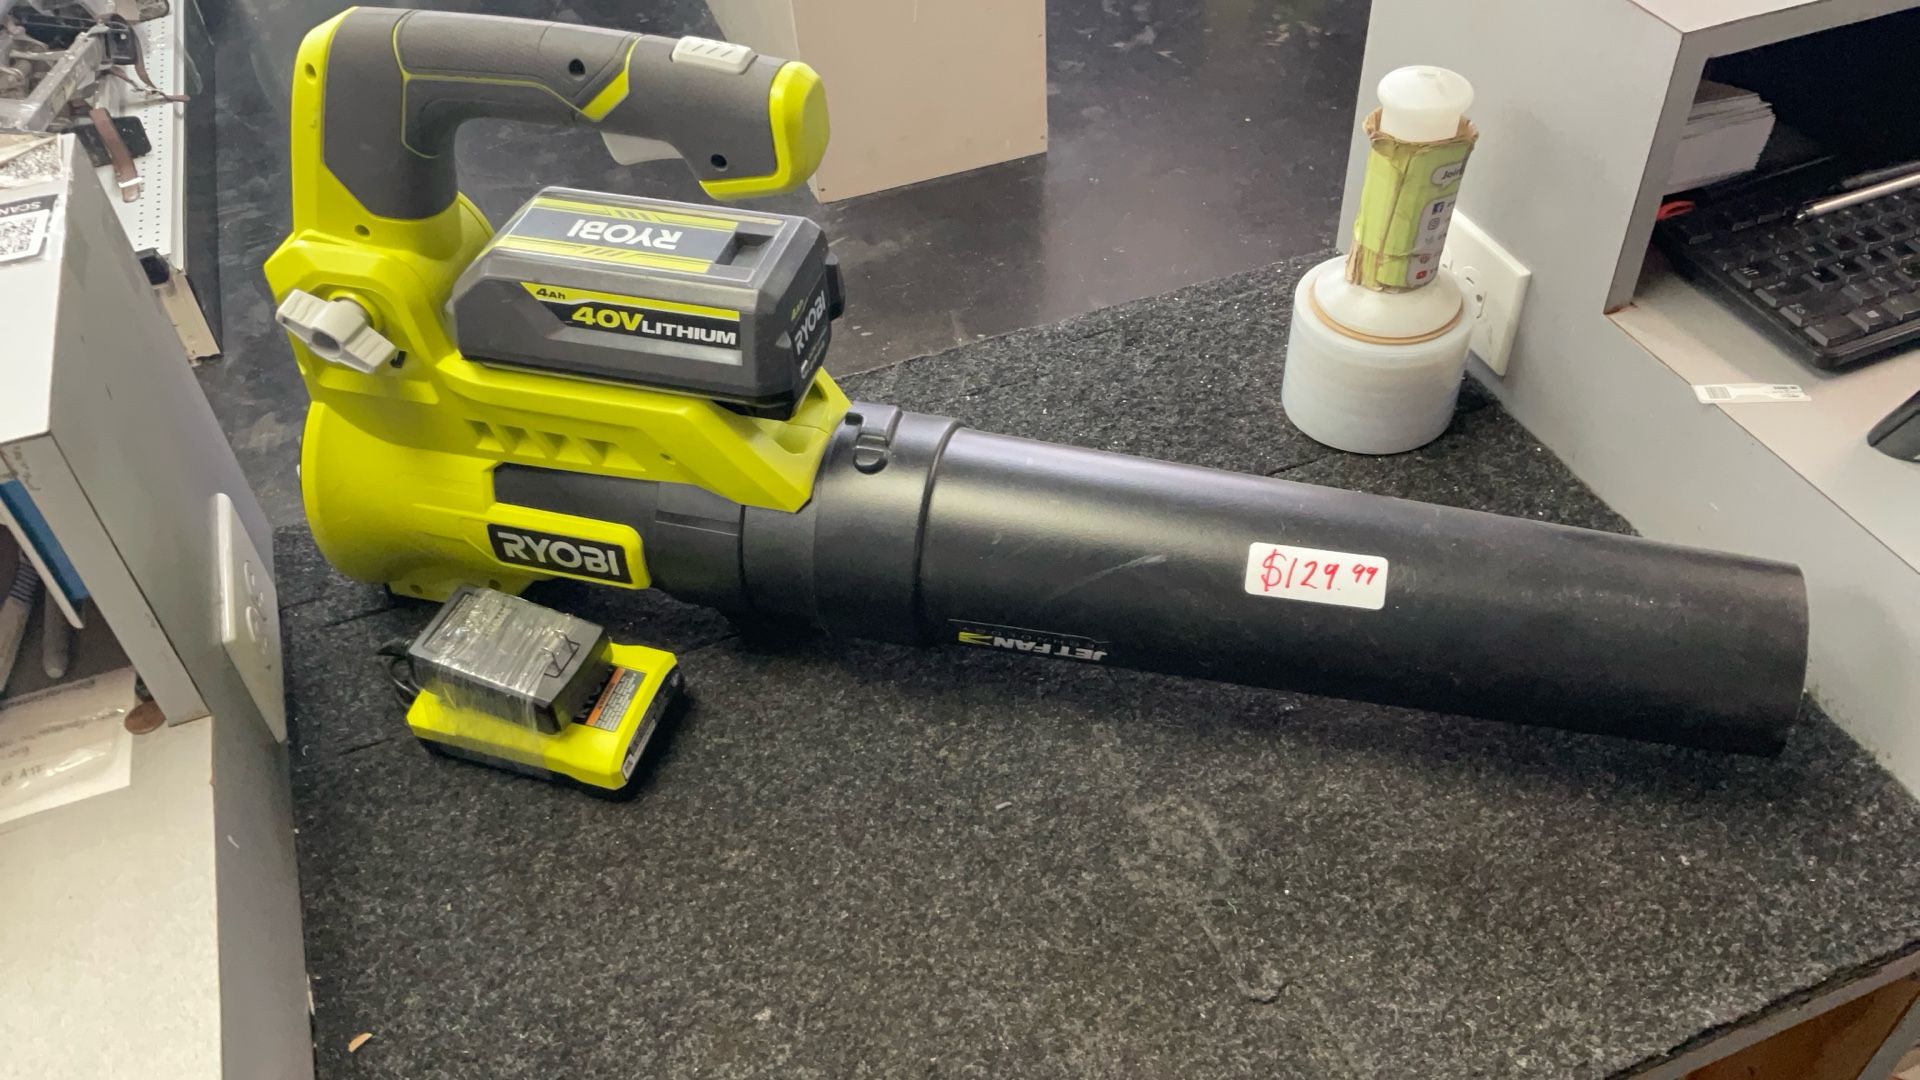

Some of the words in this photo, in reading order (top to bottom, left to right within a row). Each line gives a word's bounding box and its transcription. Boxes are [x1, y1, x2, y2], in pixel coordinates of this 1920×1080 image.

[566, 219, 684, 250] RYOBI
[536, 287, 566, 301] 4Ah
[641, 320, 736, 346] LITHIUM
[794, 289, 826, 356] RYOBI
[497, 531, 621, 577] RYOBI
[993, 636, 1051, 654] FAN
[1053, 645, 1108, 661] JET
